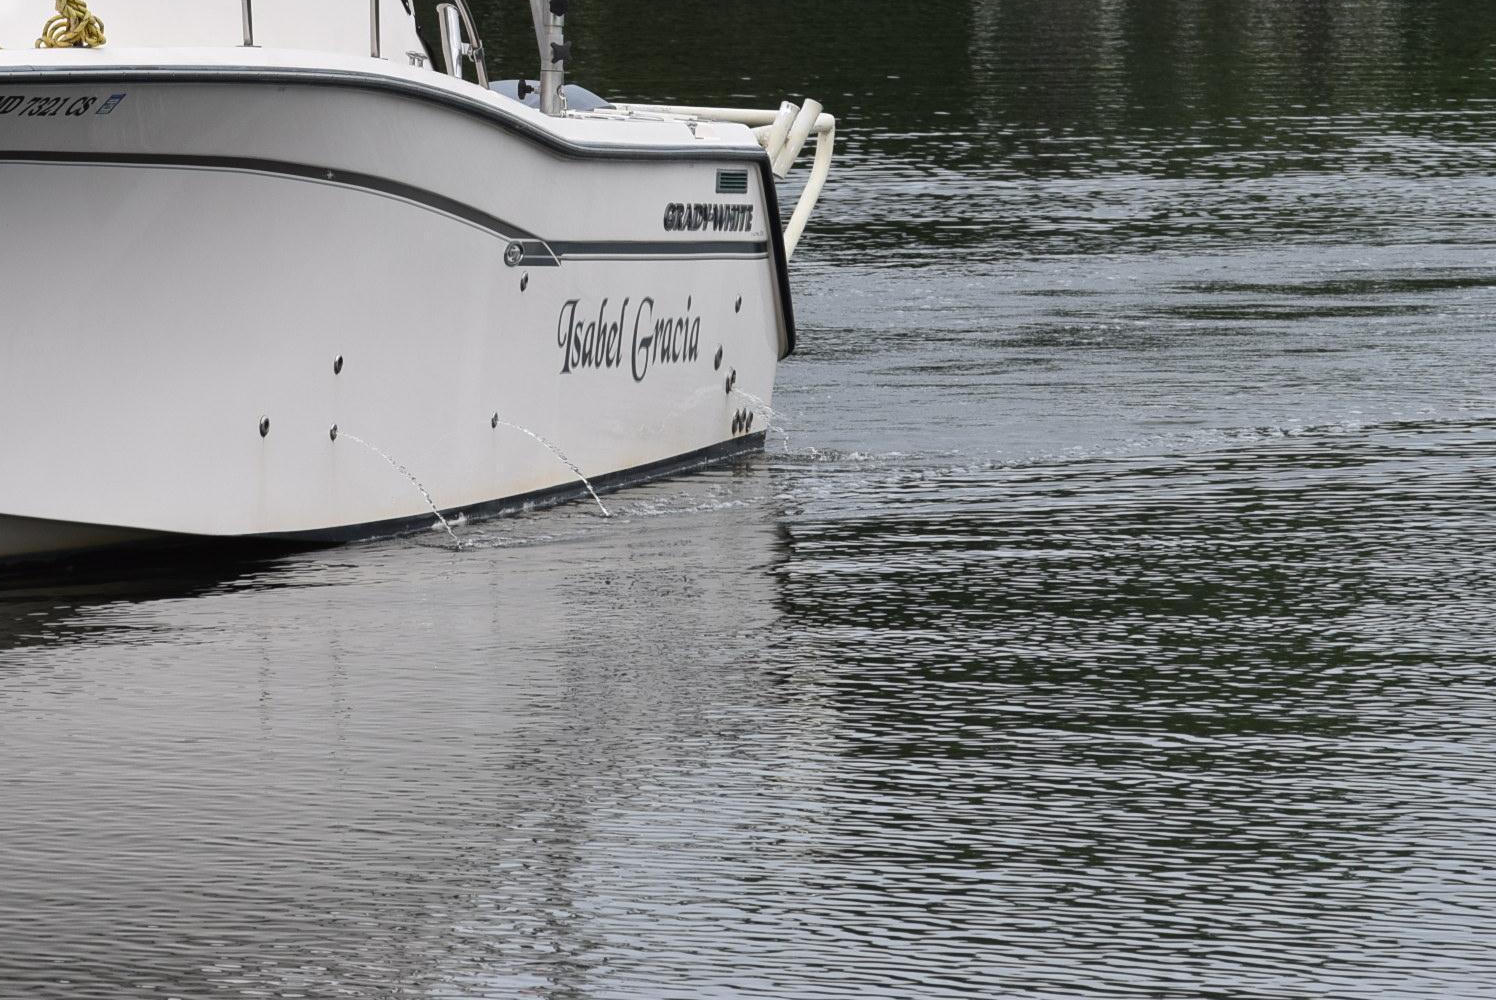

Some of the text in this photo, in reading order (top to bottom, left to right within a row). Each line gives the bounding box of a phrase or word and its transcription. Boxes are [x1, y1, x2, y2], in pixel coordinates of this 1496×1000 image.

[18, 96, 70, 117] 7321
[64, 96, 97, 117] CS
[663, 202, 754, 232] GRADY-WHITE
[557, 295, 701, 383] Isabel Gracia
